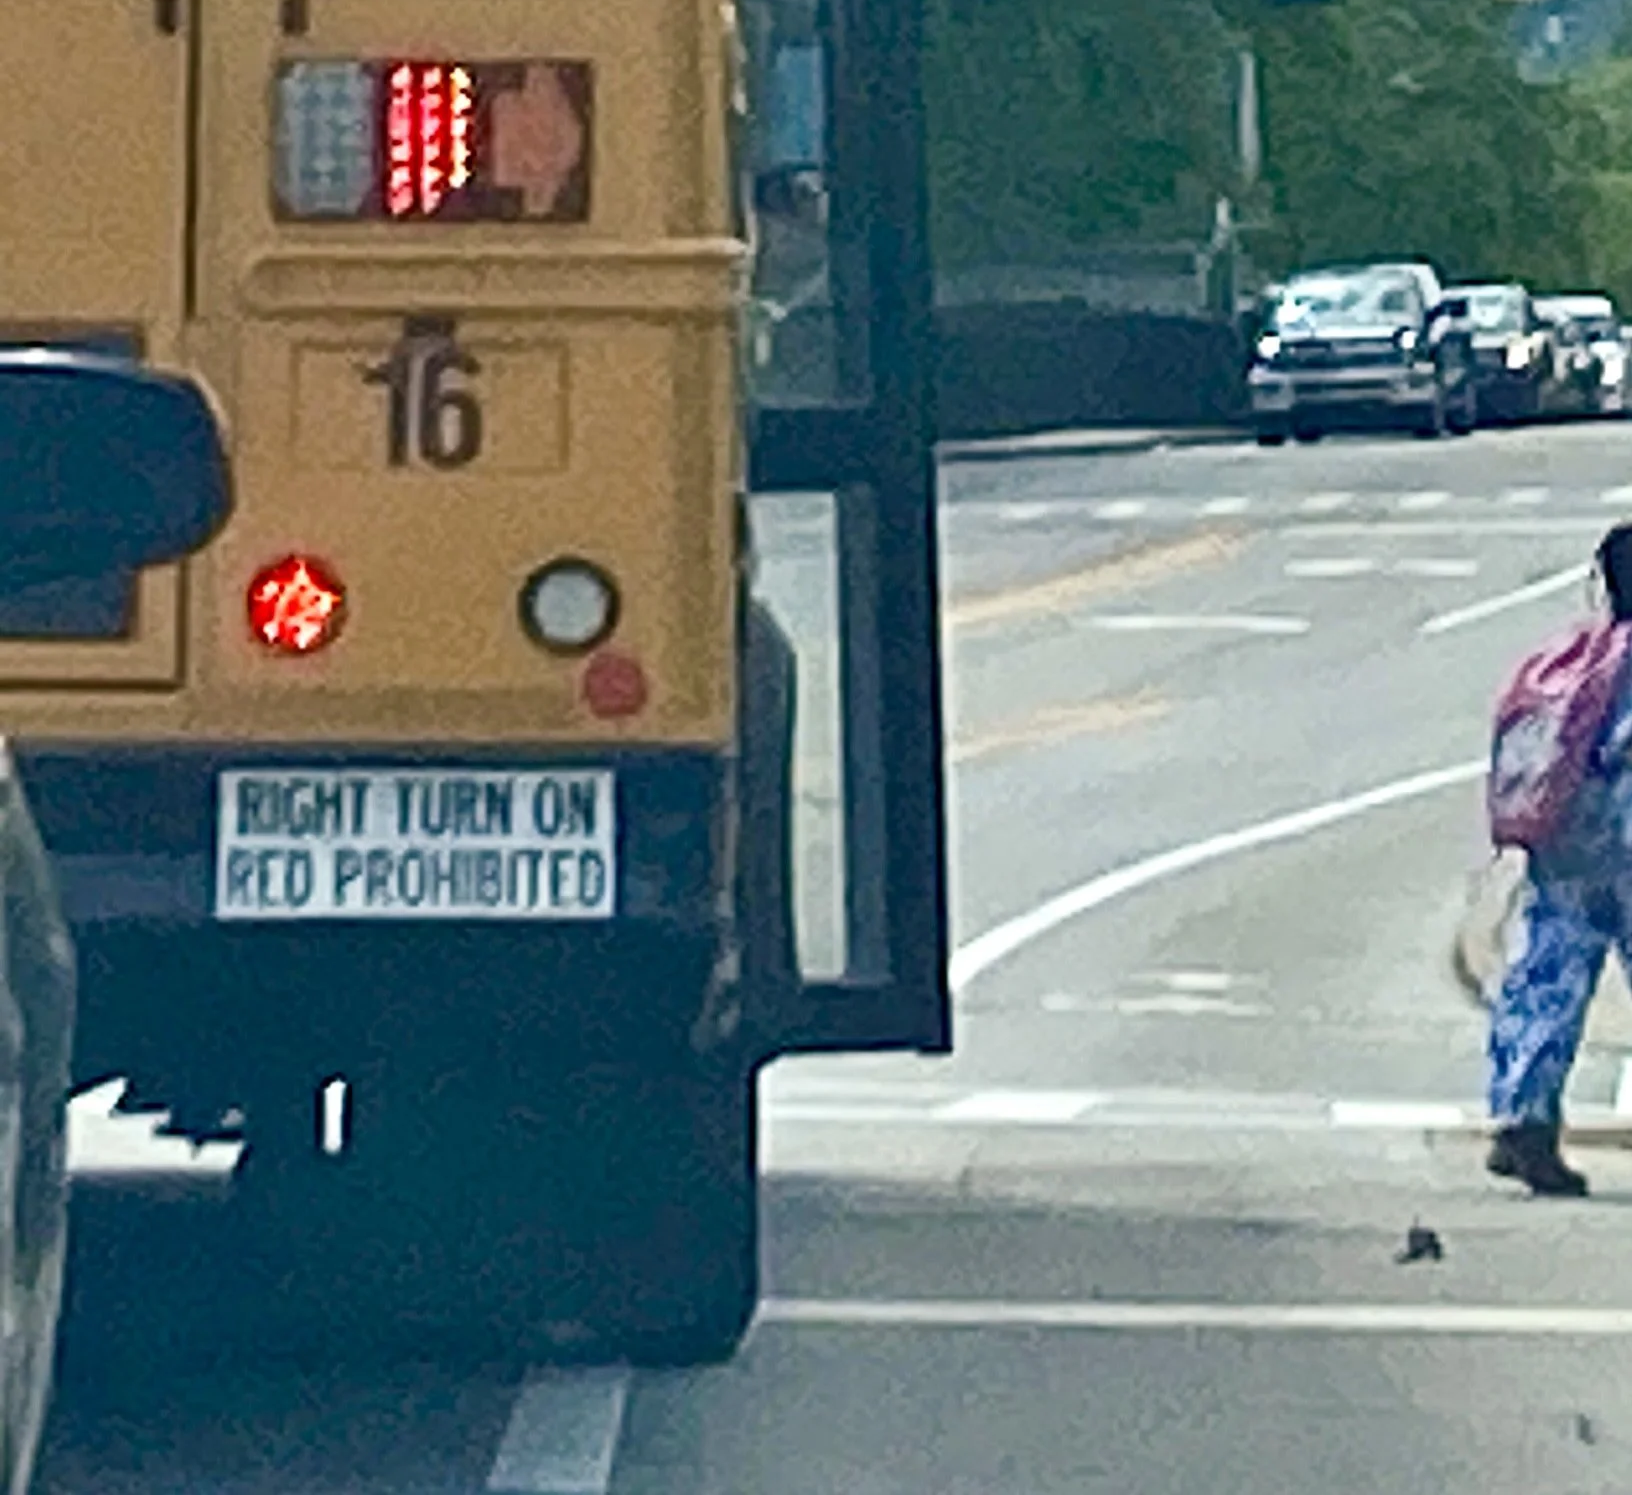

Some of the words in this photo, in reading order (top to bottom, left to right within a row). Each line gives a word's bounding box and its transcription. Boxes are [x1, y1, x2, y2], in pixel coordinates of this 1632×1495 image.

[372, 347, 483, 470] 16
[236, 778, 371, 836] RIGHT
[394, 778, 514, 835] TURN
[532, 778, 598, 837] ON
[226, 847, 313, 909] RED
[334, 847, 606, 909] PROHIBITED
